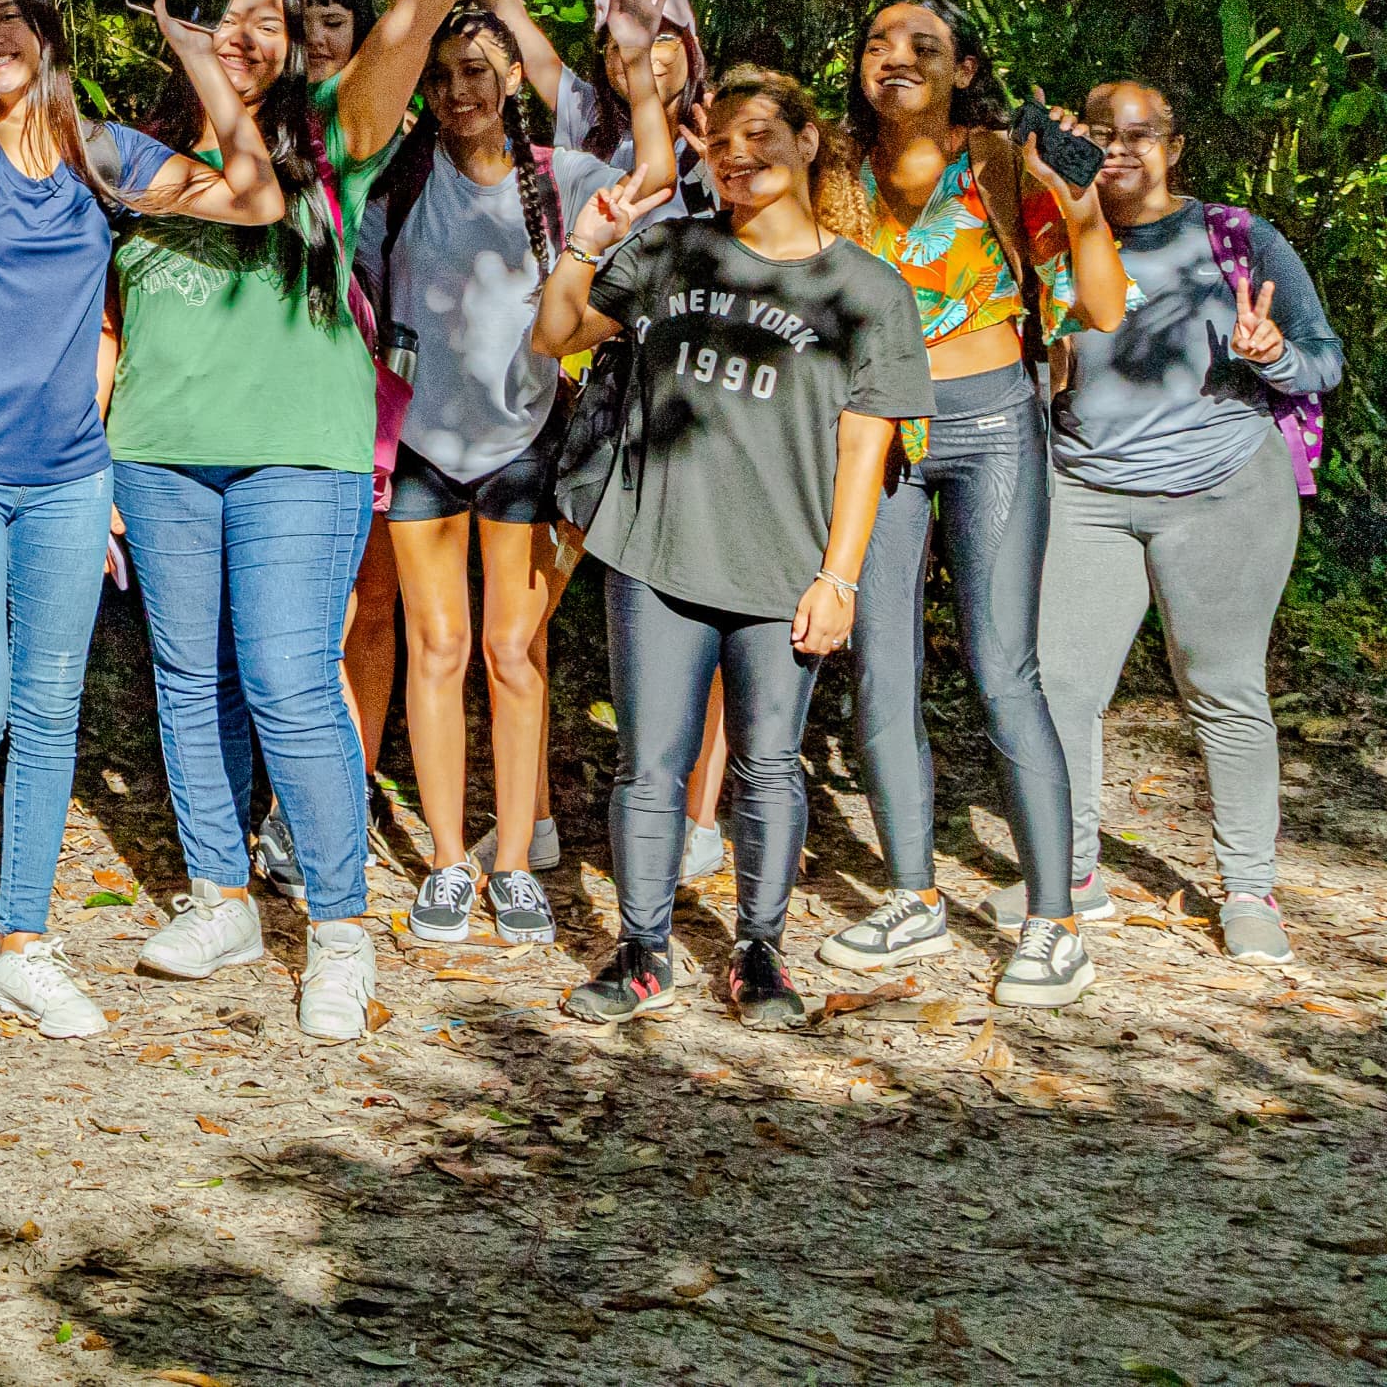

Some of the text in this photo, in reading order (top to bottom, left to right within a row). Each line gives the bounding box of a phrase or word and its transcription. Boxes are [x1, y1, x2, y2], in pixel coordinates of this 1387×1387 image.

[668, 288, 820, 354] NEW YORK
[676, 341, 777, 399] 1990
